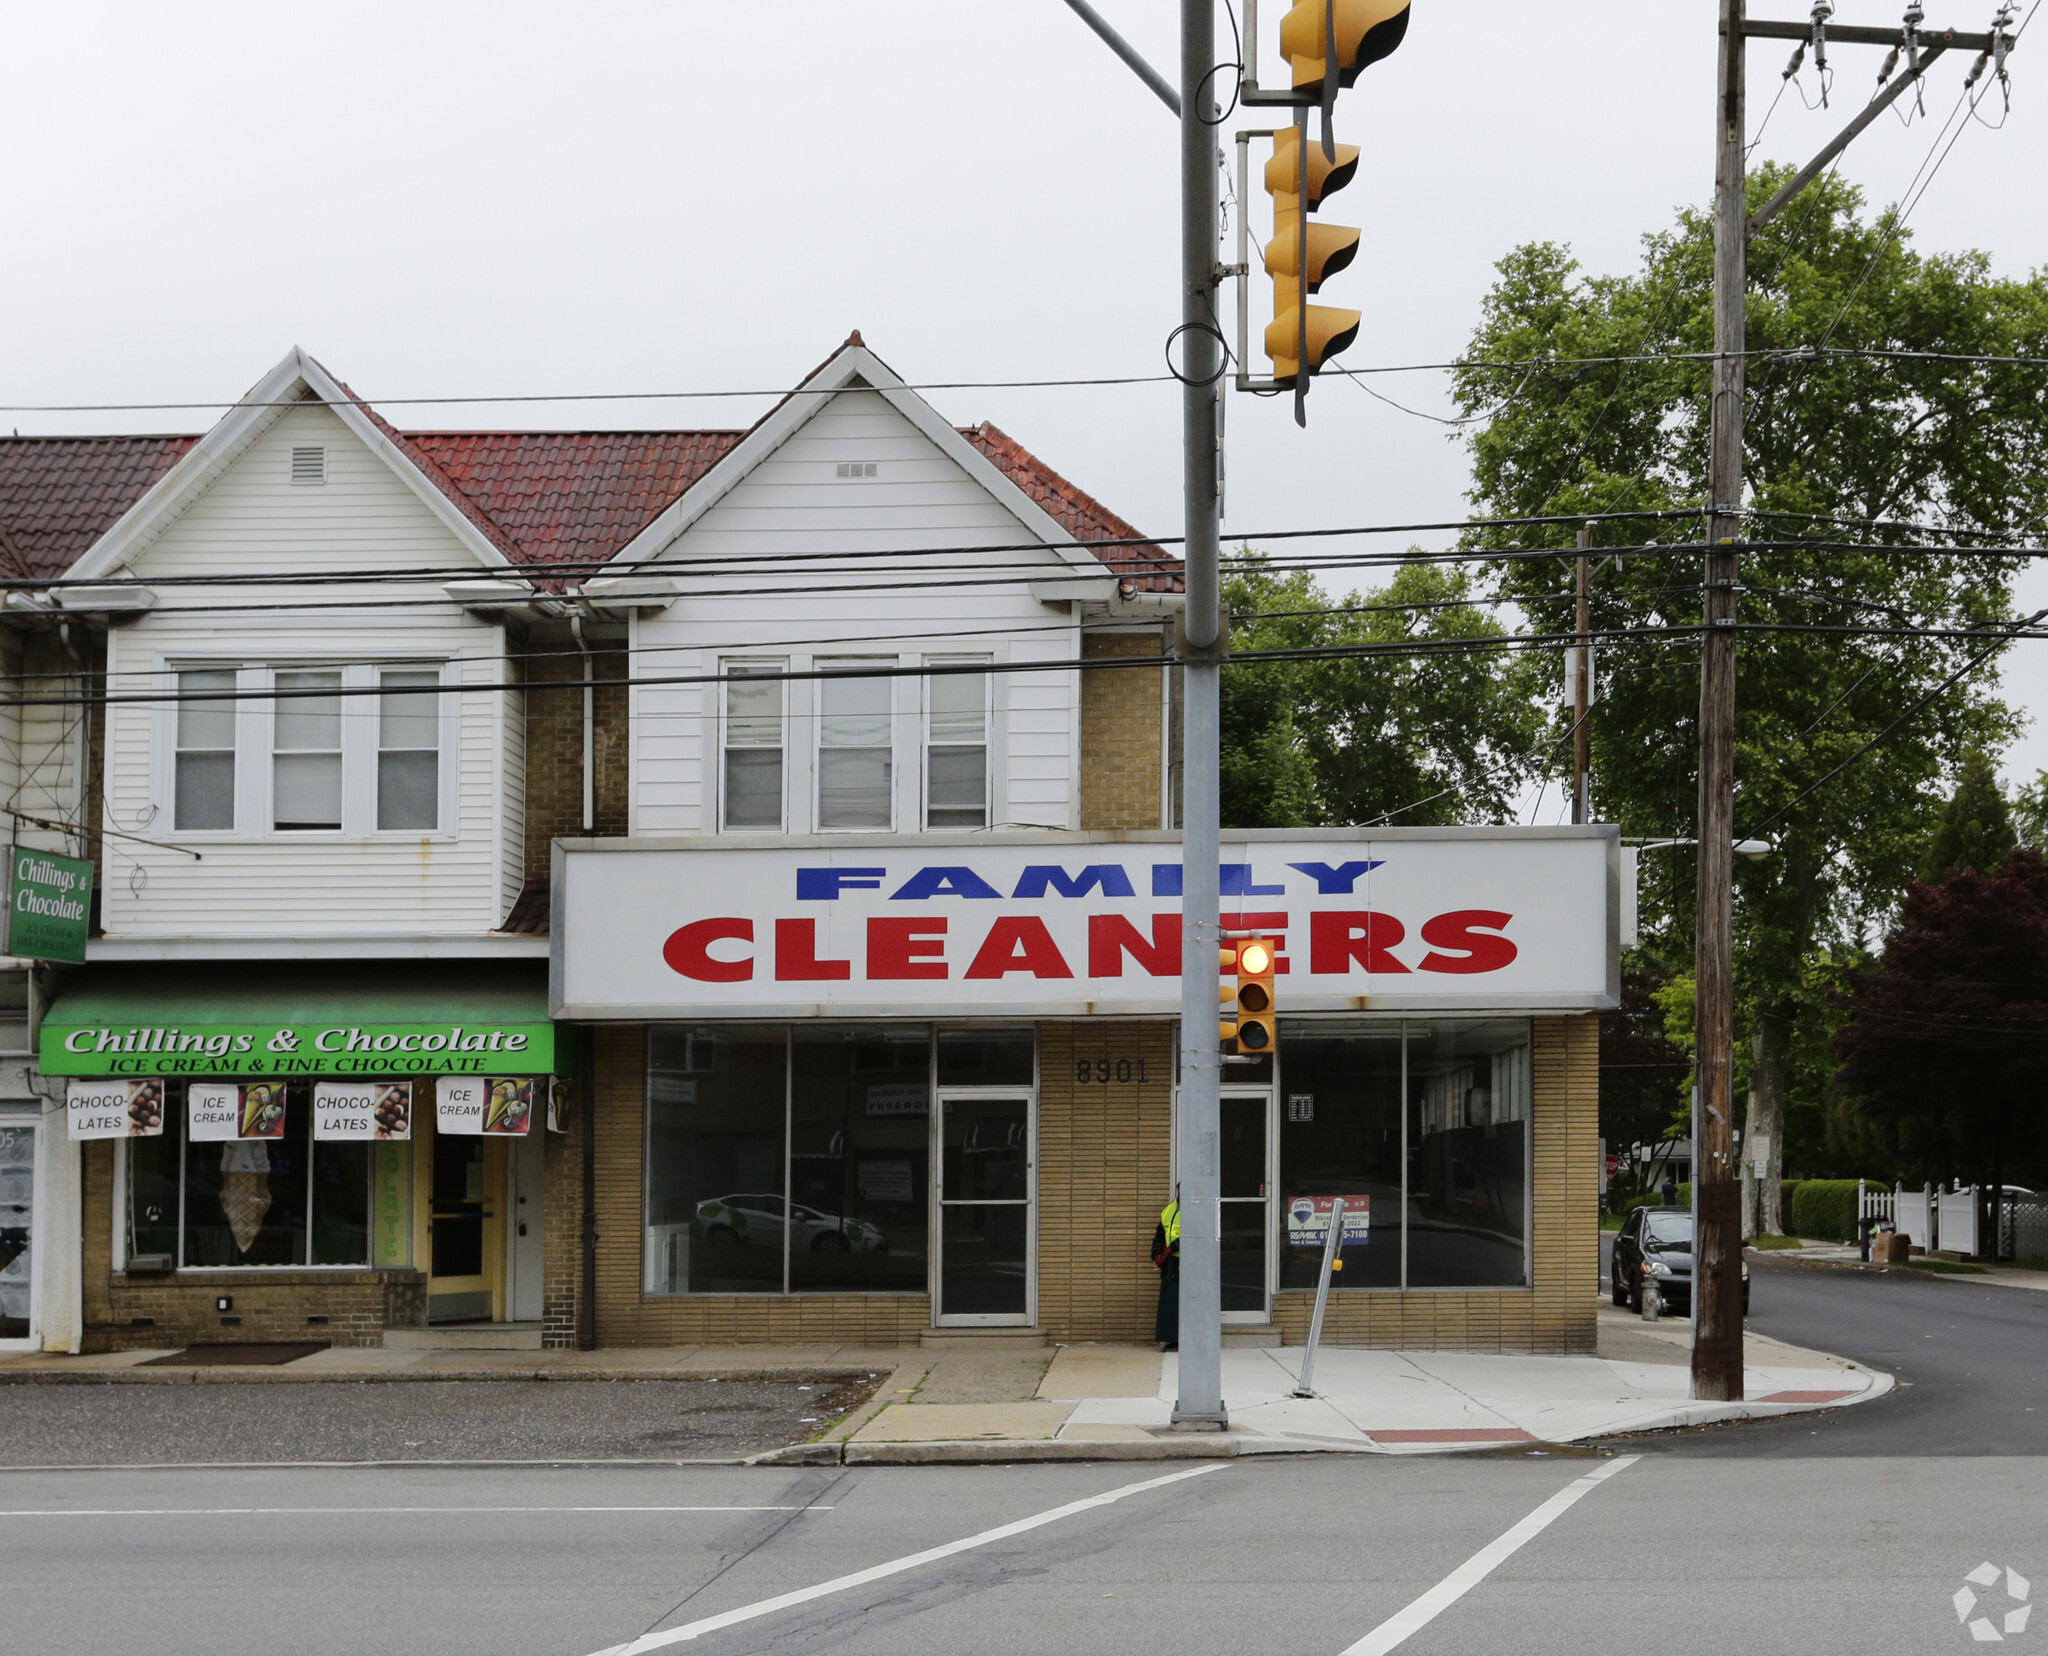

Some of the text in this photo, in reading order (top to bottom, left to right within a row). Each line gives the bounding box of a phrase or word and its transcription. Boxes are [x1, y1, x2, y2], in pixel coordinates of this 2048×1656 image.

[18, 857, 87, 893] Chillings &
[797, 860, 1387, 900] FAMILY
[17, 888, 84, 921] Chocolate
[663, 911, 1517, 982] CLEANERS
[64, 1028, 529, 1058] Chillings & Chocolate
[109, 1058, 488, 1073] ICE CREAM & FINE CHOCOLATE
[1077, 1058, 1150, 1084] 8901
[70, 1095, 128, 1109] CHOCO-
[449, 1090, 471, 1101] ICE
[203, 1097, 226, 1108] ICE
[316, 1097, 375, 1109] CHOCO-
[439, 1105, 480, 1116] CREAM
[78, 1117, 122, 1130] LATES
[193, 1113, 235, 1123] CREAM
[323, 1119, 368, 1130] LATES
[1606, 1161, 1618, 1170] TOP
